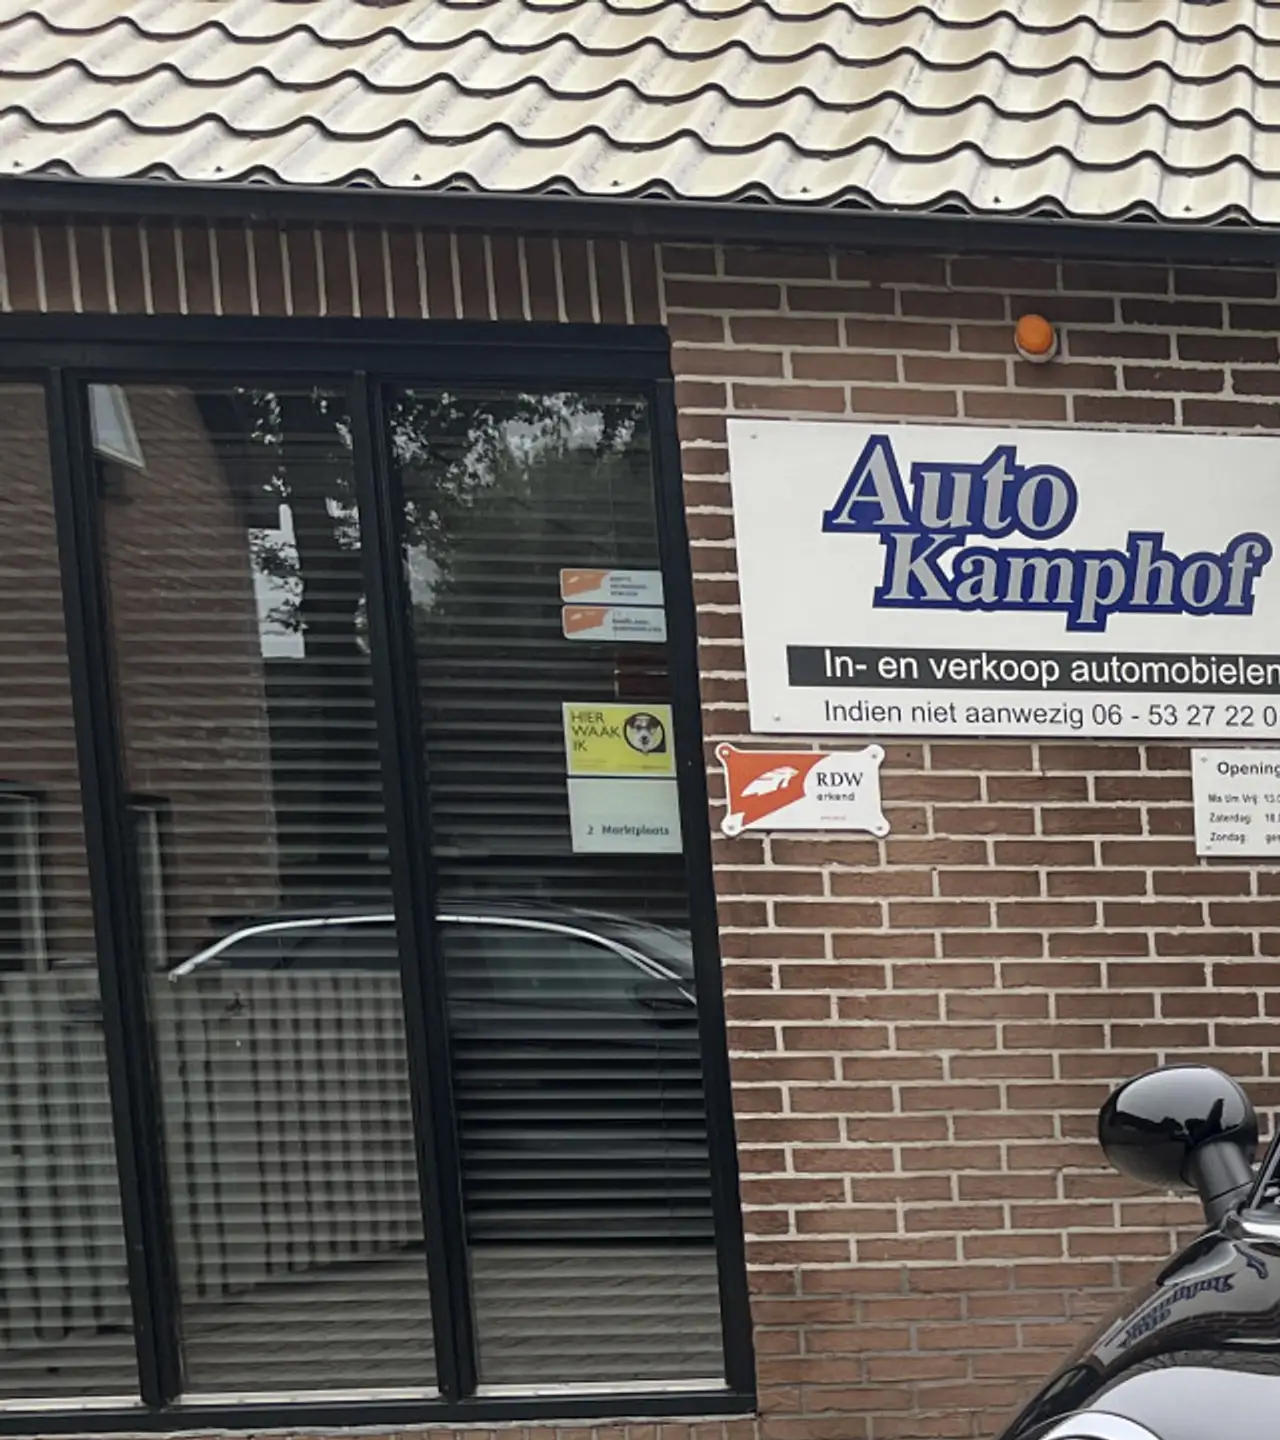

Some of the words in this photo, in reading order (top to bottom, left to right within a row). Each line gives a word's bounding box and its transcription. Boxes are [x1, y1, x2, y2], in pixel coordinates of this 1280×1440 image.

[822, 435, 1078, 540] Auto
[873, 531, 1272, 632] Kamphof
[824, 649, 868, 677] In-
[878, 655, 918, 680] en
[929, 652, 1060, 688] verkoop
[571, 711, 604, 723] HIER
[825, 700, 901, 722] Indien
[912, 701, 957, 723] niet
[966, 703, 1083, 729] aanwezig
[1092, 703, 1123, 726] 06
[1149, 704, 1178, 726] 53
[1187, 705, 1216, 727] 27
[1225, 706, 1254, 727] 22
[572, 725, 621, 739] WAAK
[573, 739, 588, 751] IK
[816, 771, 863, 787] RDW
[816, 791, 855, 802] erkend
[602, 824, 669, 836] Marktplaats
